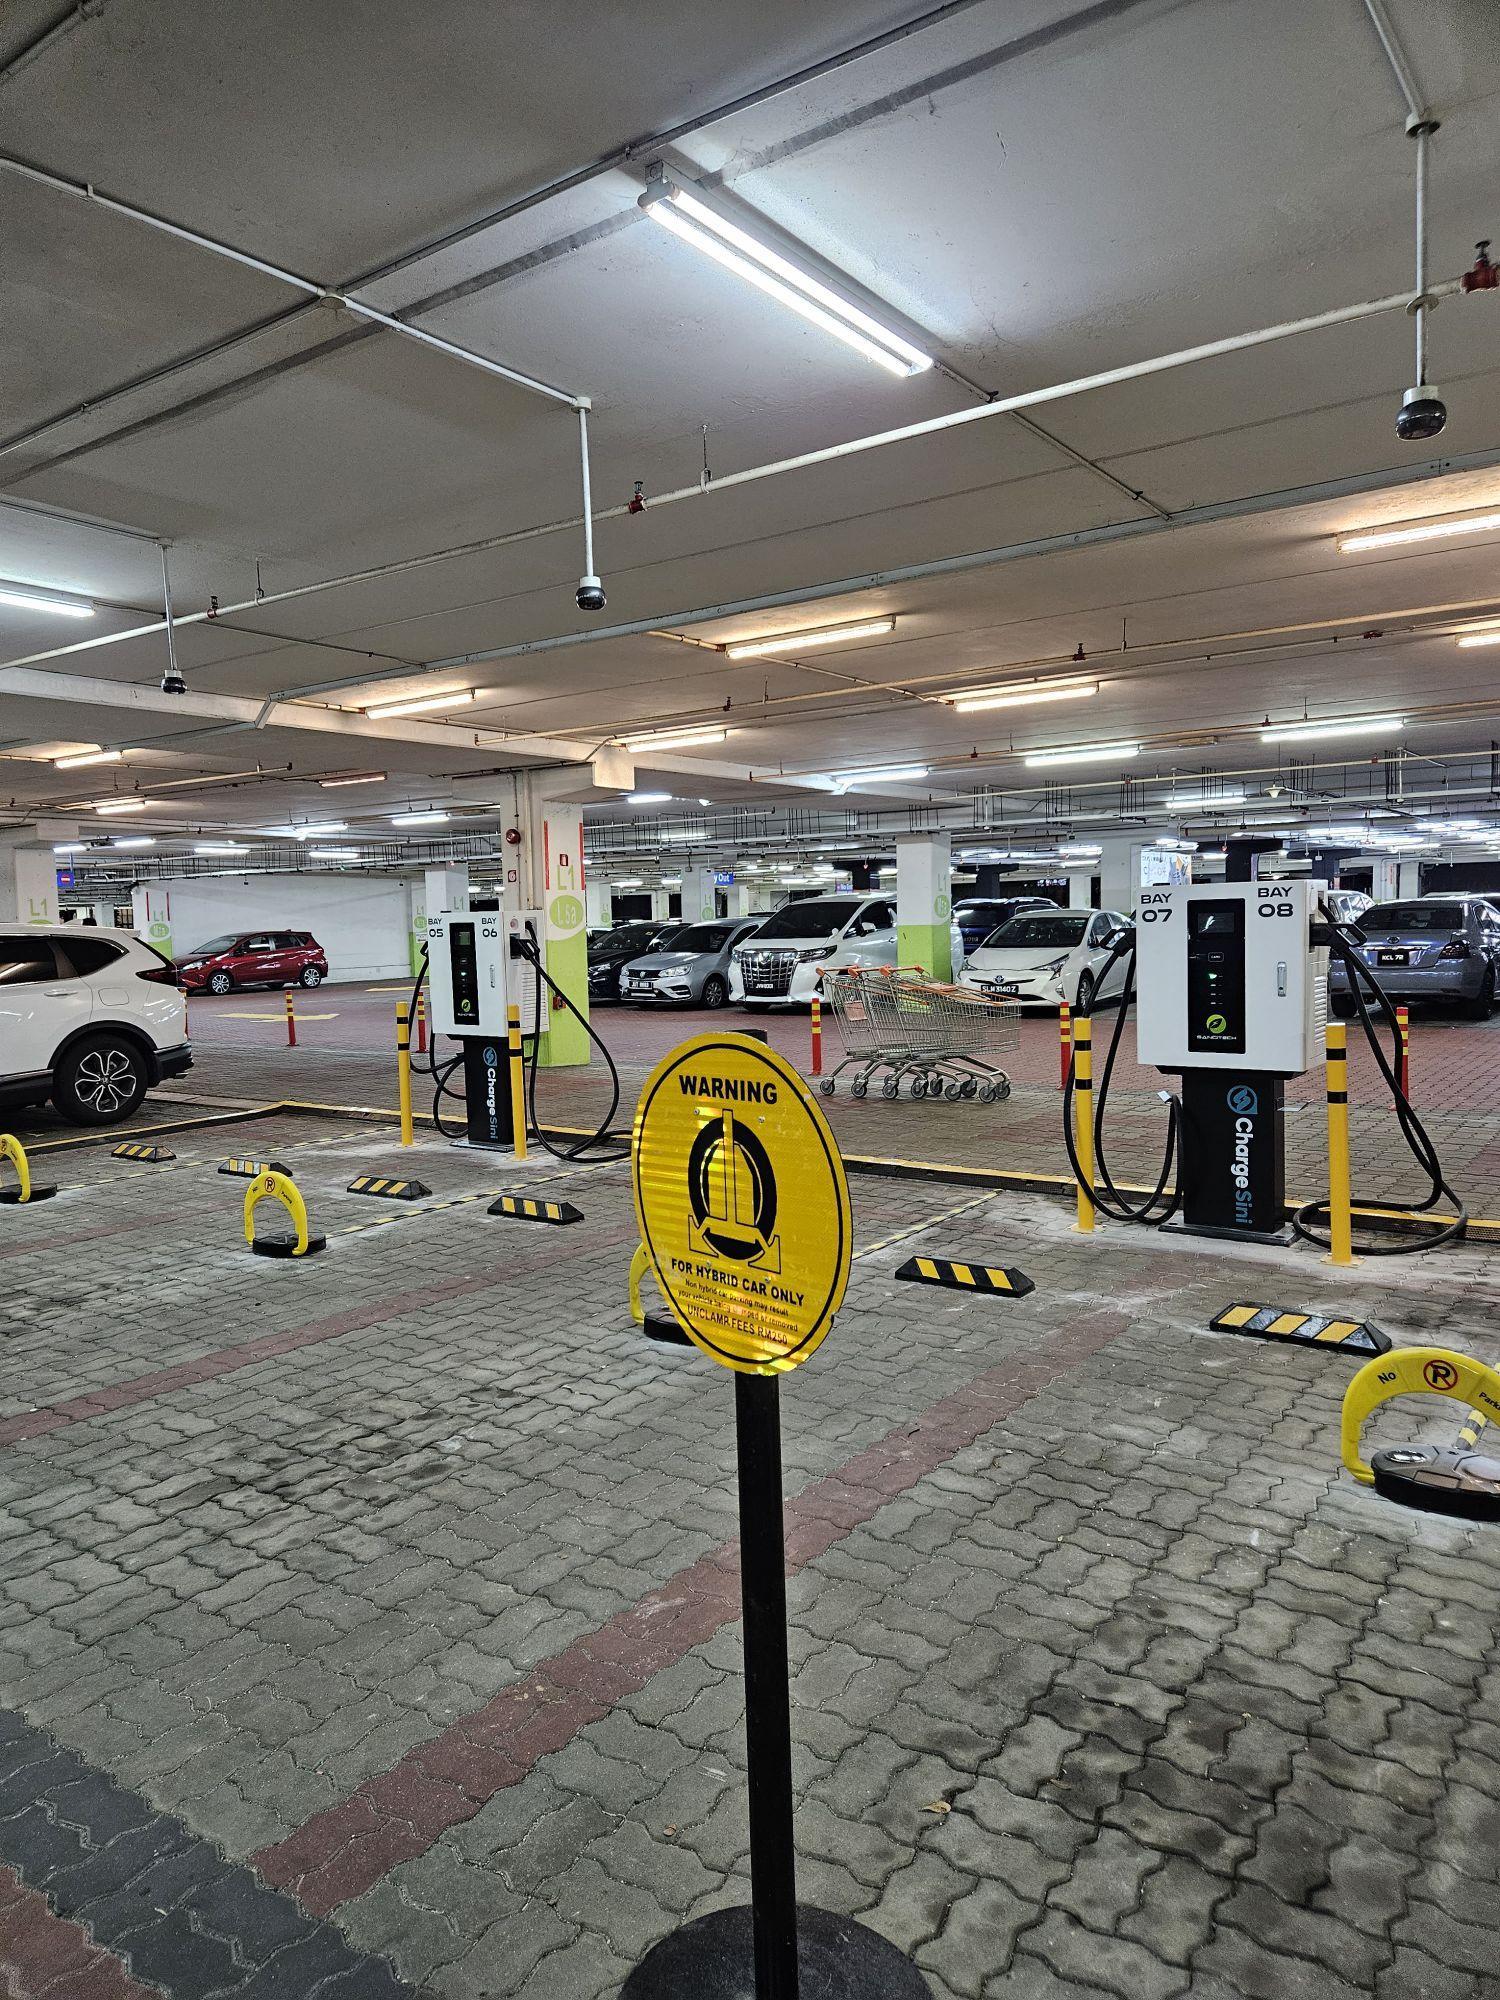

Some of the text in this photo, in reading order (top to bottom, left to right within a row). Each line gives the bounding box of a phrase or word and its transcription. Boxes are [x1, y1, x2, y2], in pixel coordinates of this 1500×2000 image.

[557, 865, 575, 890] L1
[1140, 893, 1172, 904] BAY
[1258, 887, 1293, 898] BAY
[29, 898, 48, 916] L1
[1258, 903, 1294, 918] 08
[153, 910, 164, 921] L1
[481, 917, 497, 925] BAY
[1141, 908, 1173, 923] 07
[429, 929, 444, 938] 05
[482, 928, 498, 938] 06
[678, 1074, 778, 1105] WARNING
[1230, 1117, 1254, 1225] ChargeSini
[671, 1257, 805, 1307] FOR HYBRID CAR ONLY
[685, 1278, 698, 1290] Non
[698, 1281, 717, 1296] hybrid
[754, 1301, 768, 1313] may
[769, 1303, 789, 1317] result
[686, 1302, 788, 1345] UNCLAMP FEES RM250
[1377, 1371, 1396, 1385] No
